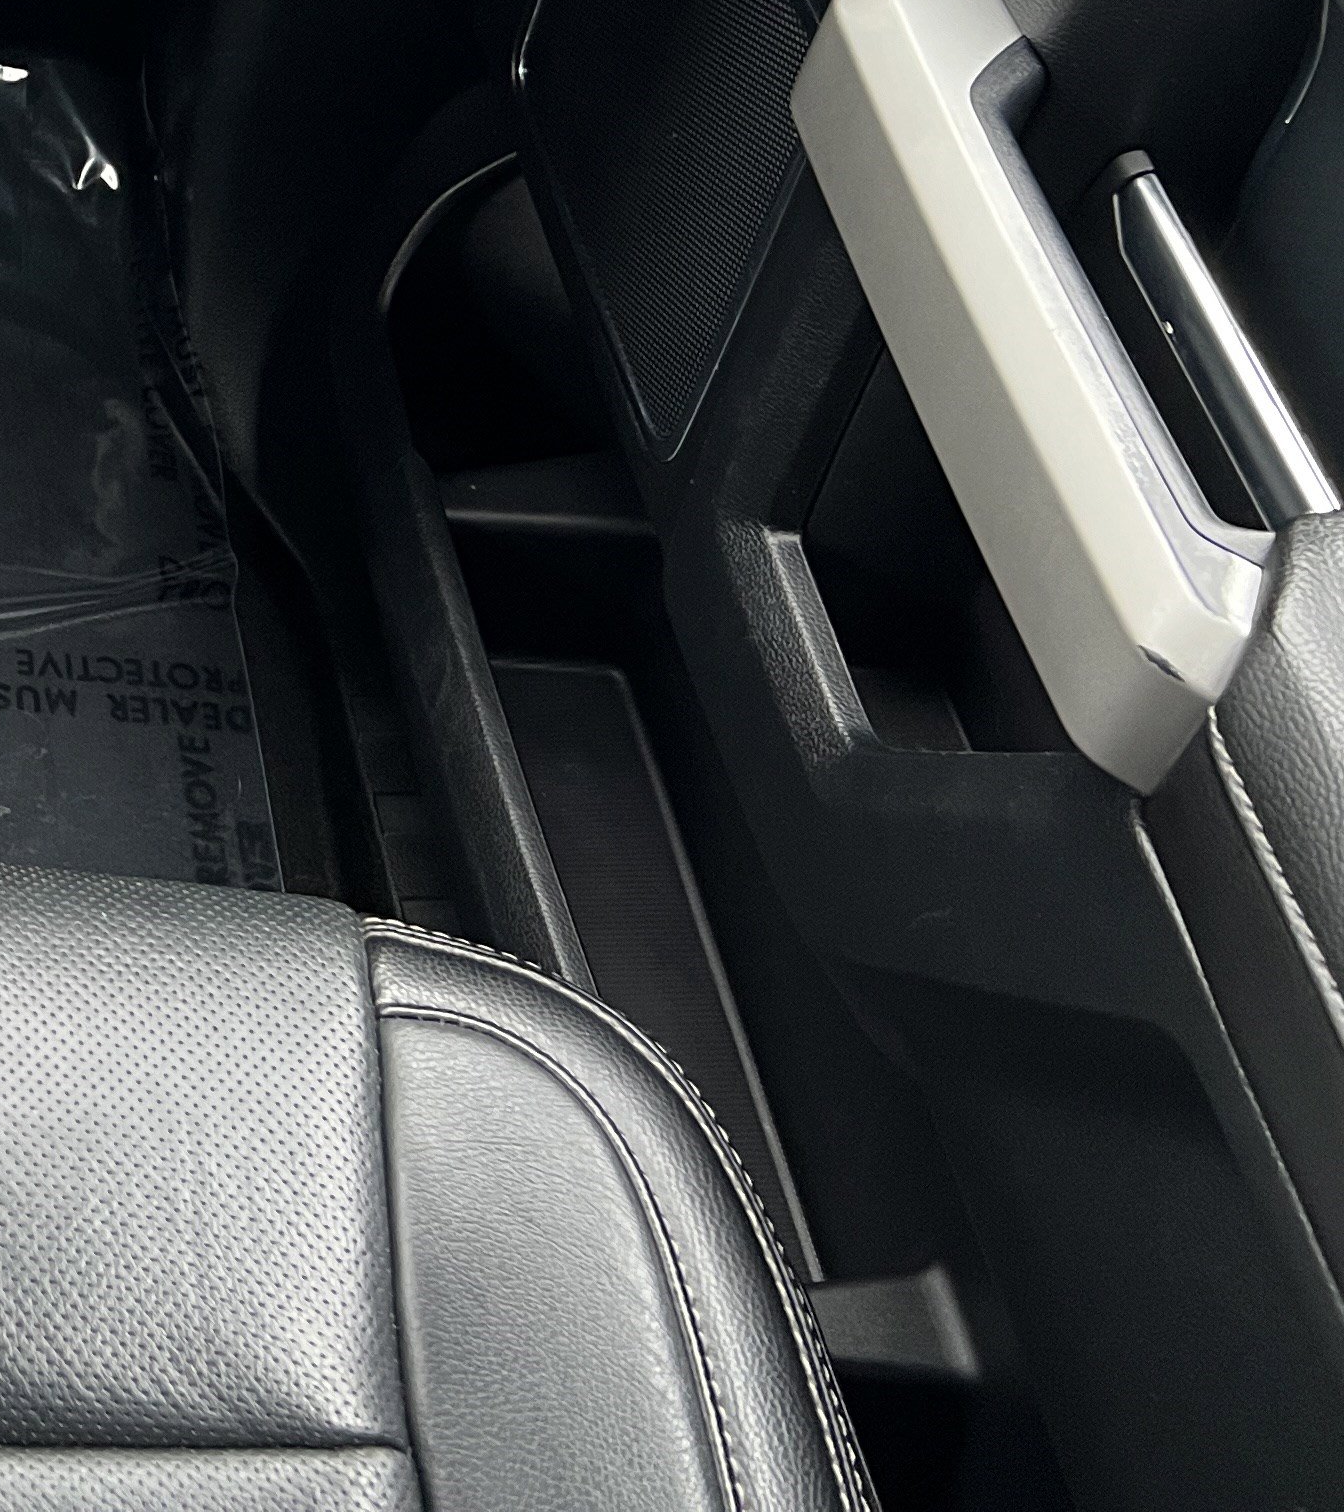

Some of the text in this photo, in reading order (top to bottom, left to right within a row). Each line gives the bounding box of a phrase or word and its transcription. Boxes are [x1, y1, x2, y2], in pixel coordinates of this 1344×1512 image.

[14, 645, 246, 695] PROTECTIVE
[109, 692, 255, 734] DEALER
[178, 733, 229, 886] REMOVE
